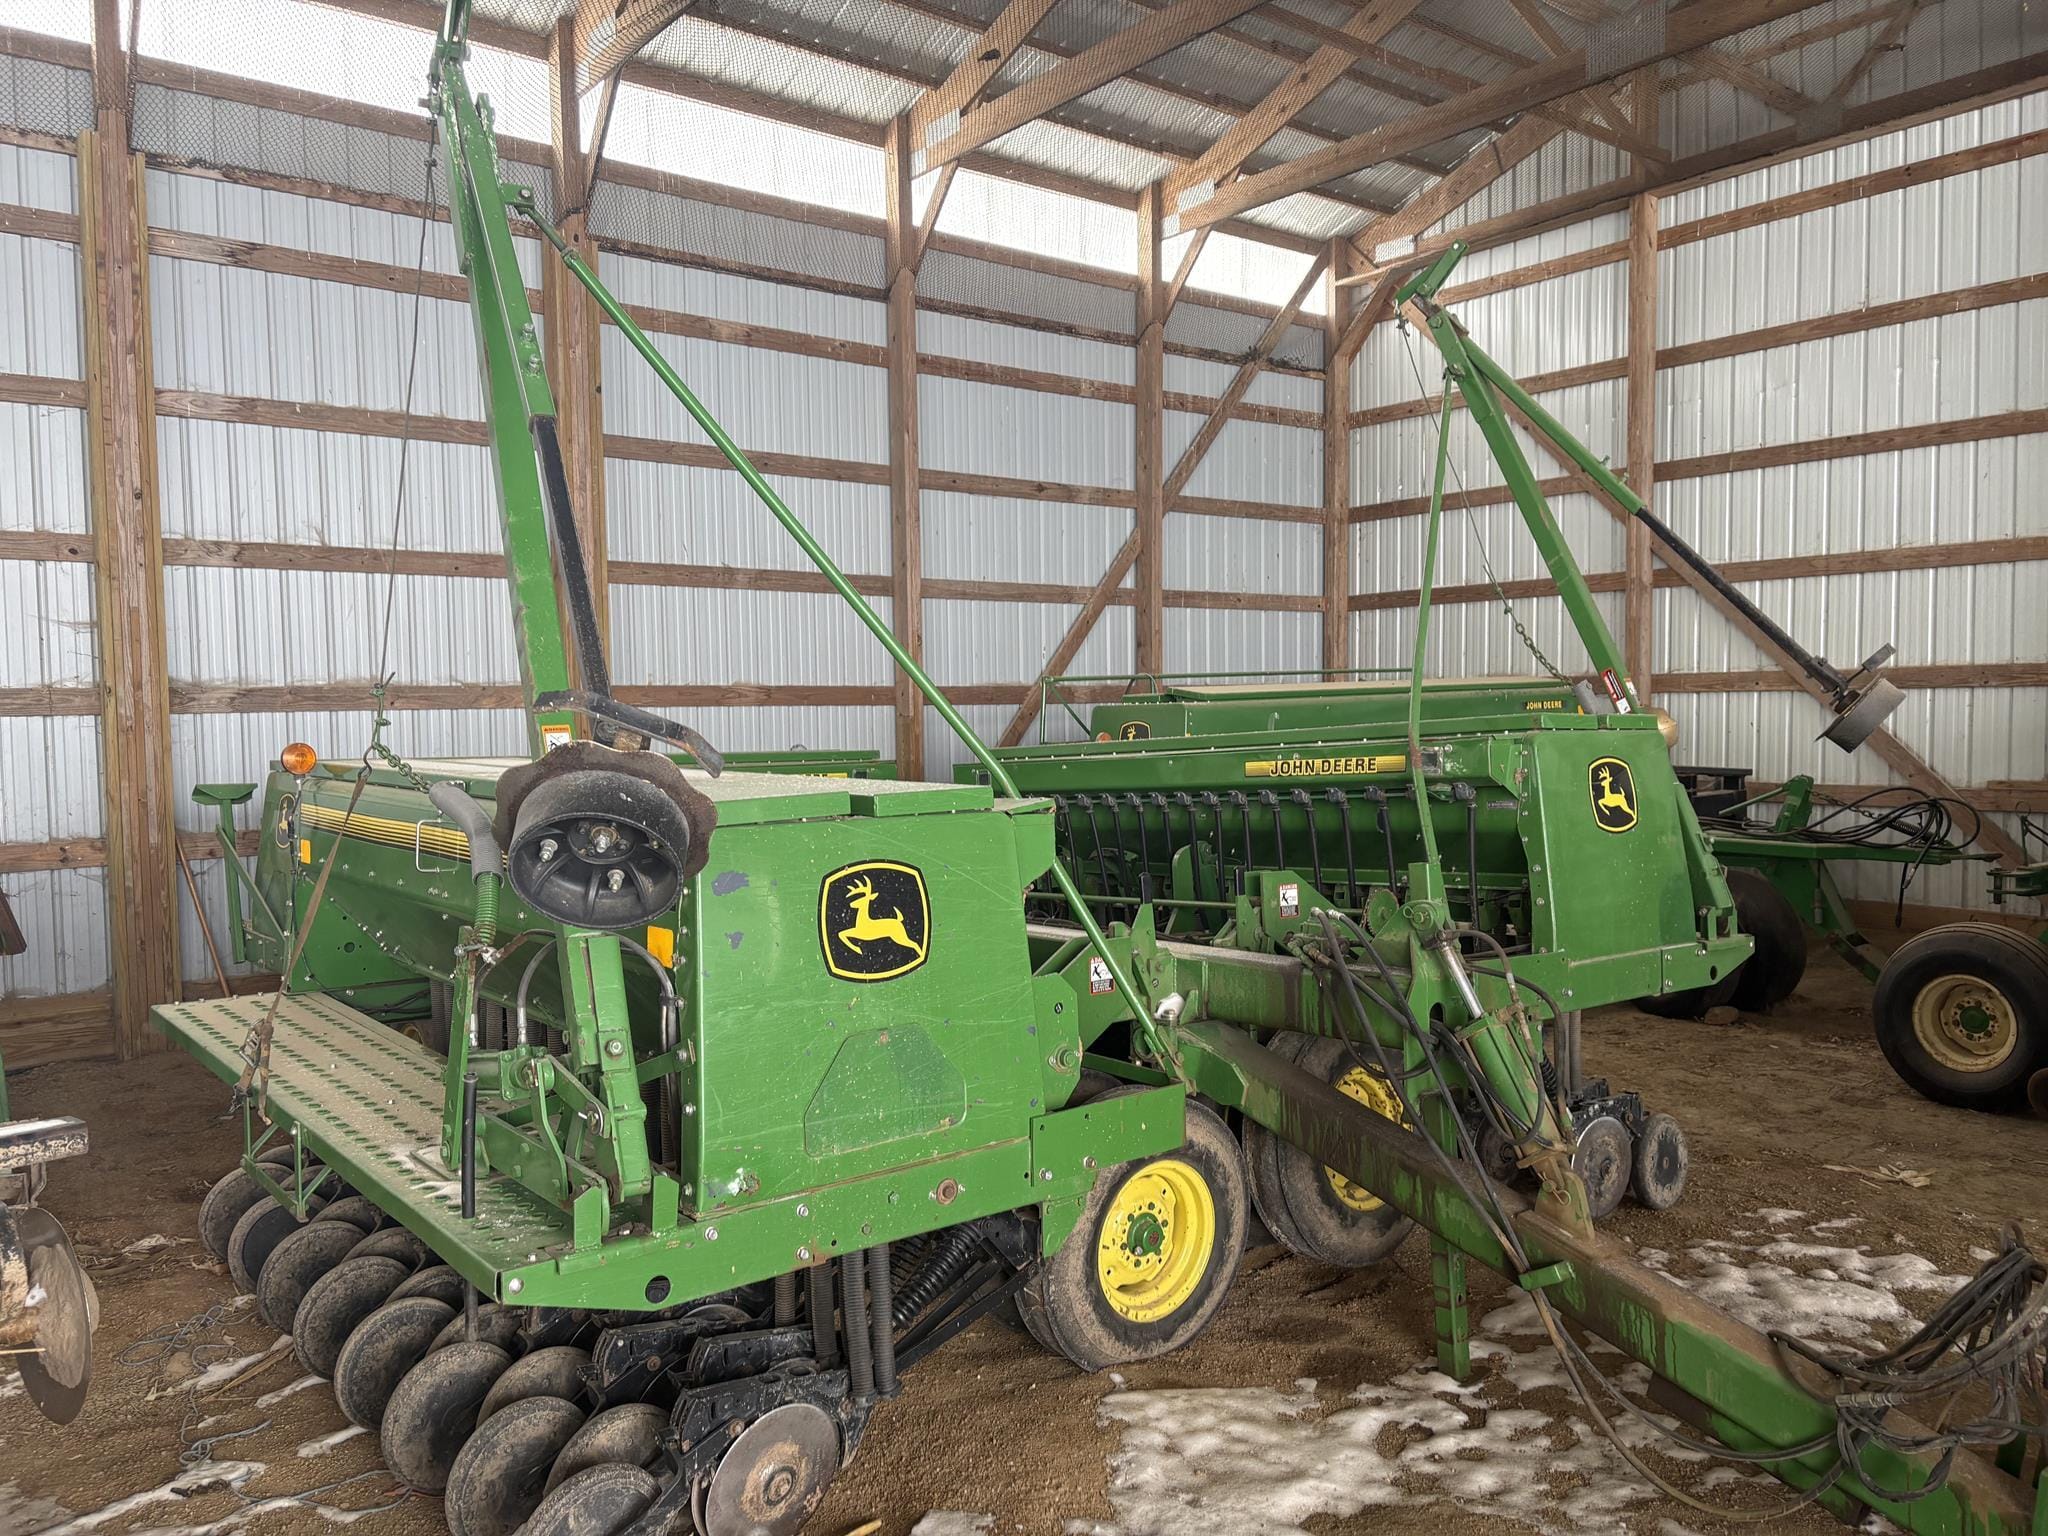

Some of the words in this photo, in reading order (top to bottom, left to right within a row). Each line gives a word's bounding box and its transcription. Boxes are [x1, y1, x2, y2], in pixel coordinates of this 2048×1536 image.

[1526, 701, 1542, 710] JOHN
[1543, 700, 1562, 709] DEERE
[1271, 760, 1315, 776] JOHN
[1321, 757, 1376, 774] DEERE
